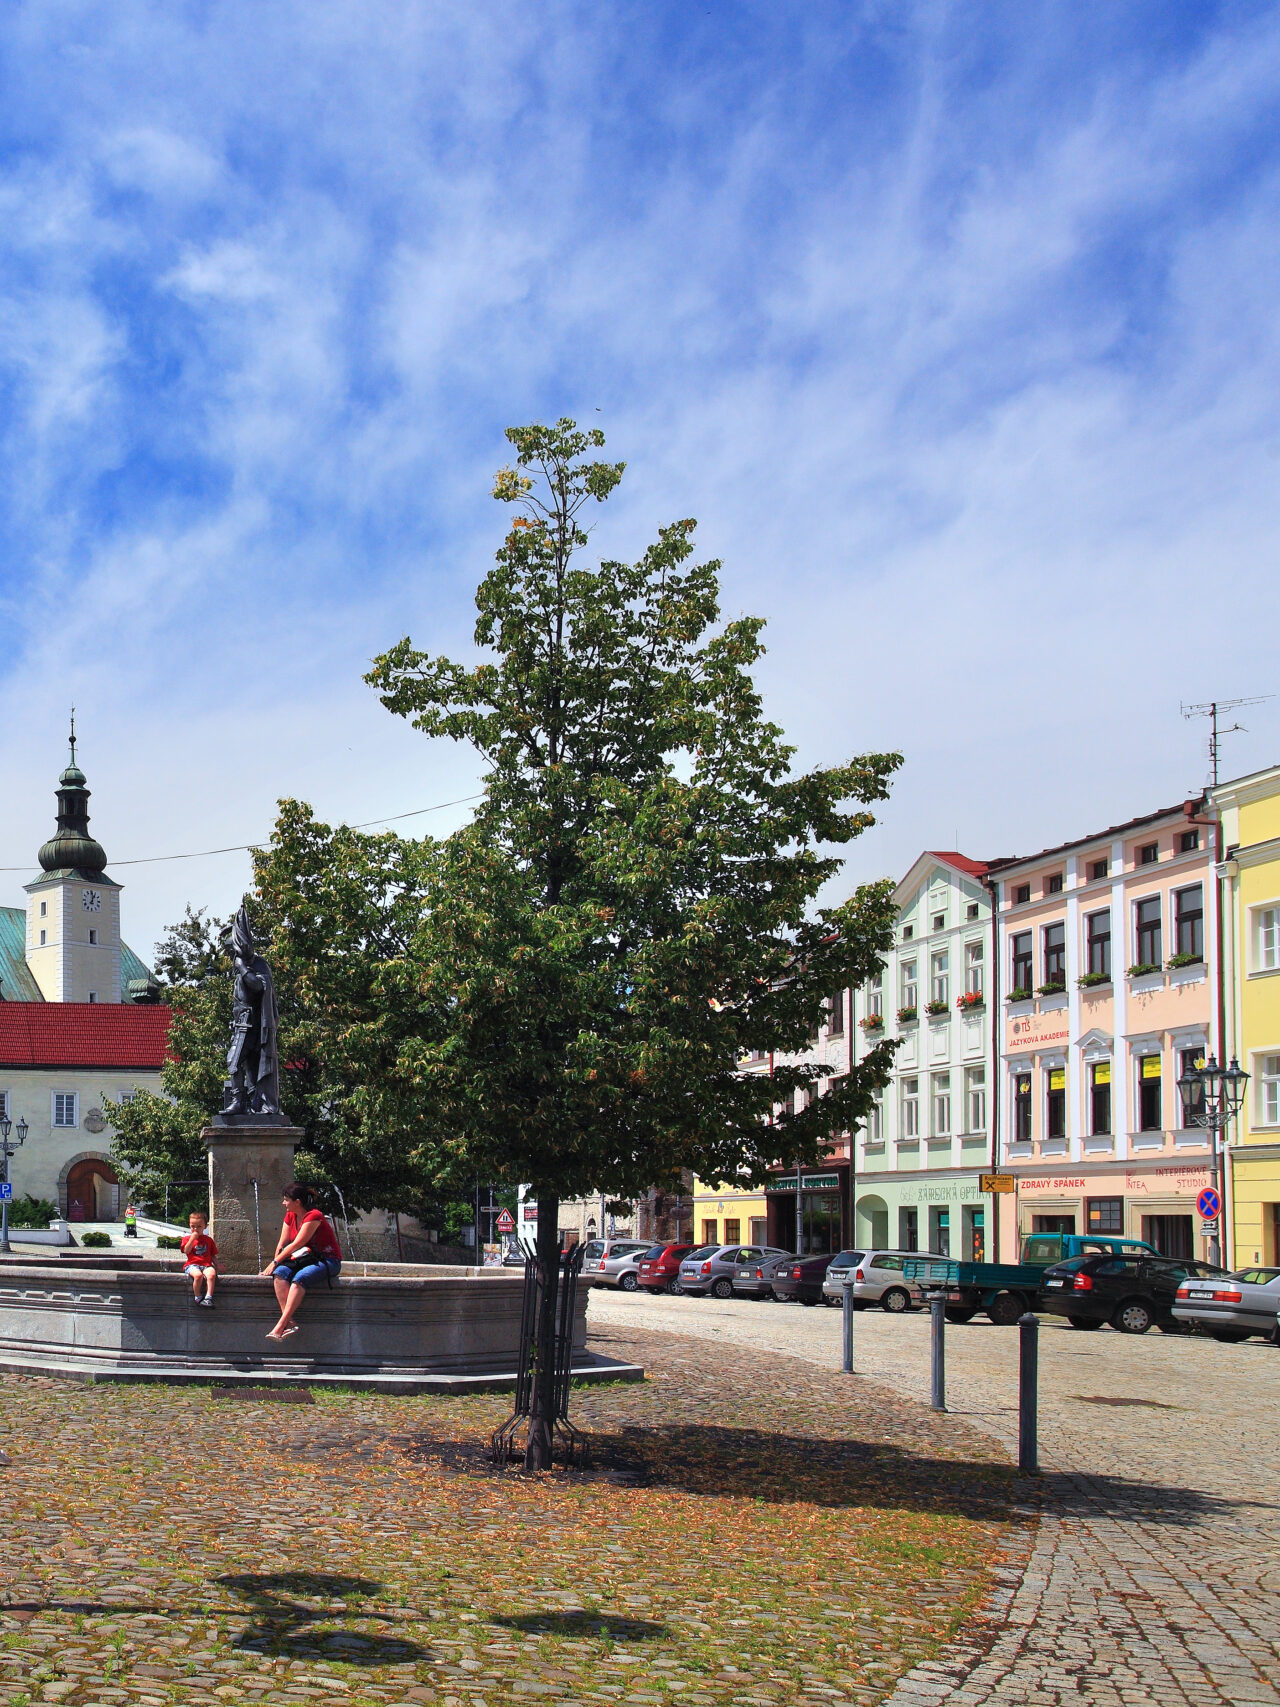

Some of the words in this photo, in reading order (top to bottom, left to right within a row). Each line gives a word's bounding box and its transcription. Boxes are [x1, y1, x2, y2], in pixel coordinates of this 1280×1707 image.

[1040, 1030, 1070, 1042] AKADEMIE
[1021, 1177, 1051, 1189] ZDRAVÝ
[1053, 1177, 1086, 1188] SPÁNEK
[1176, 1178, 1207, 1188] STUDIO
